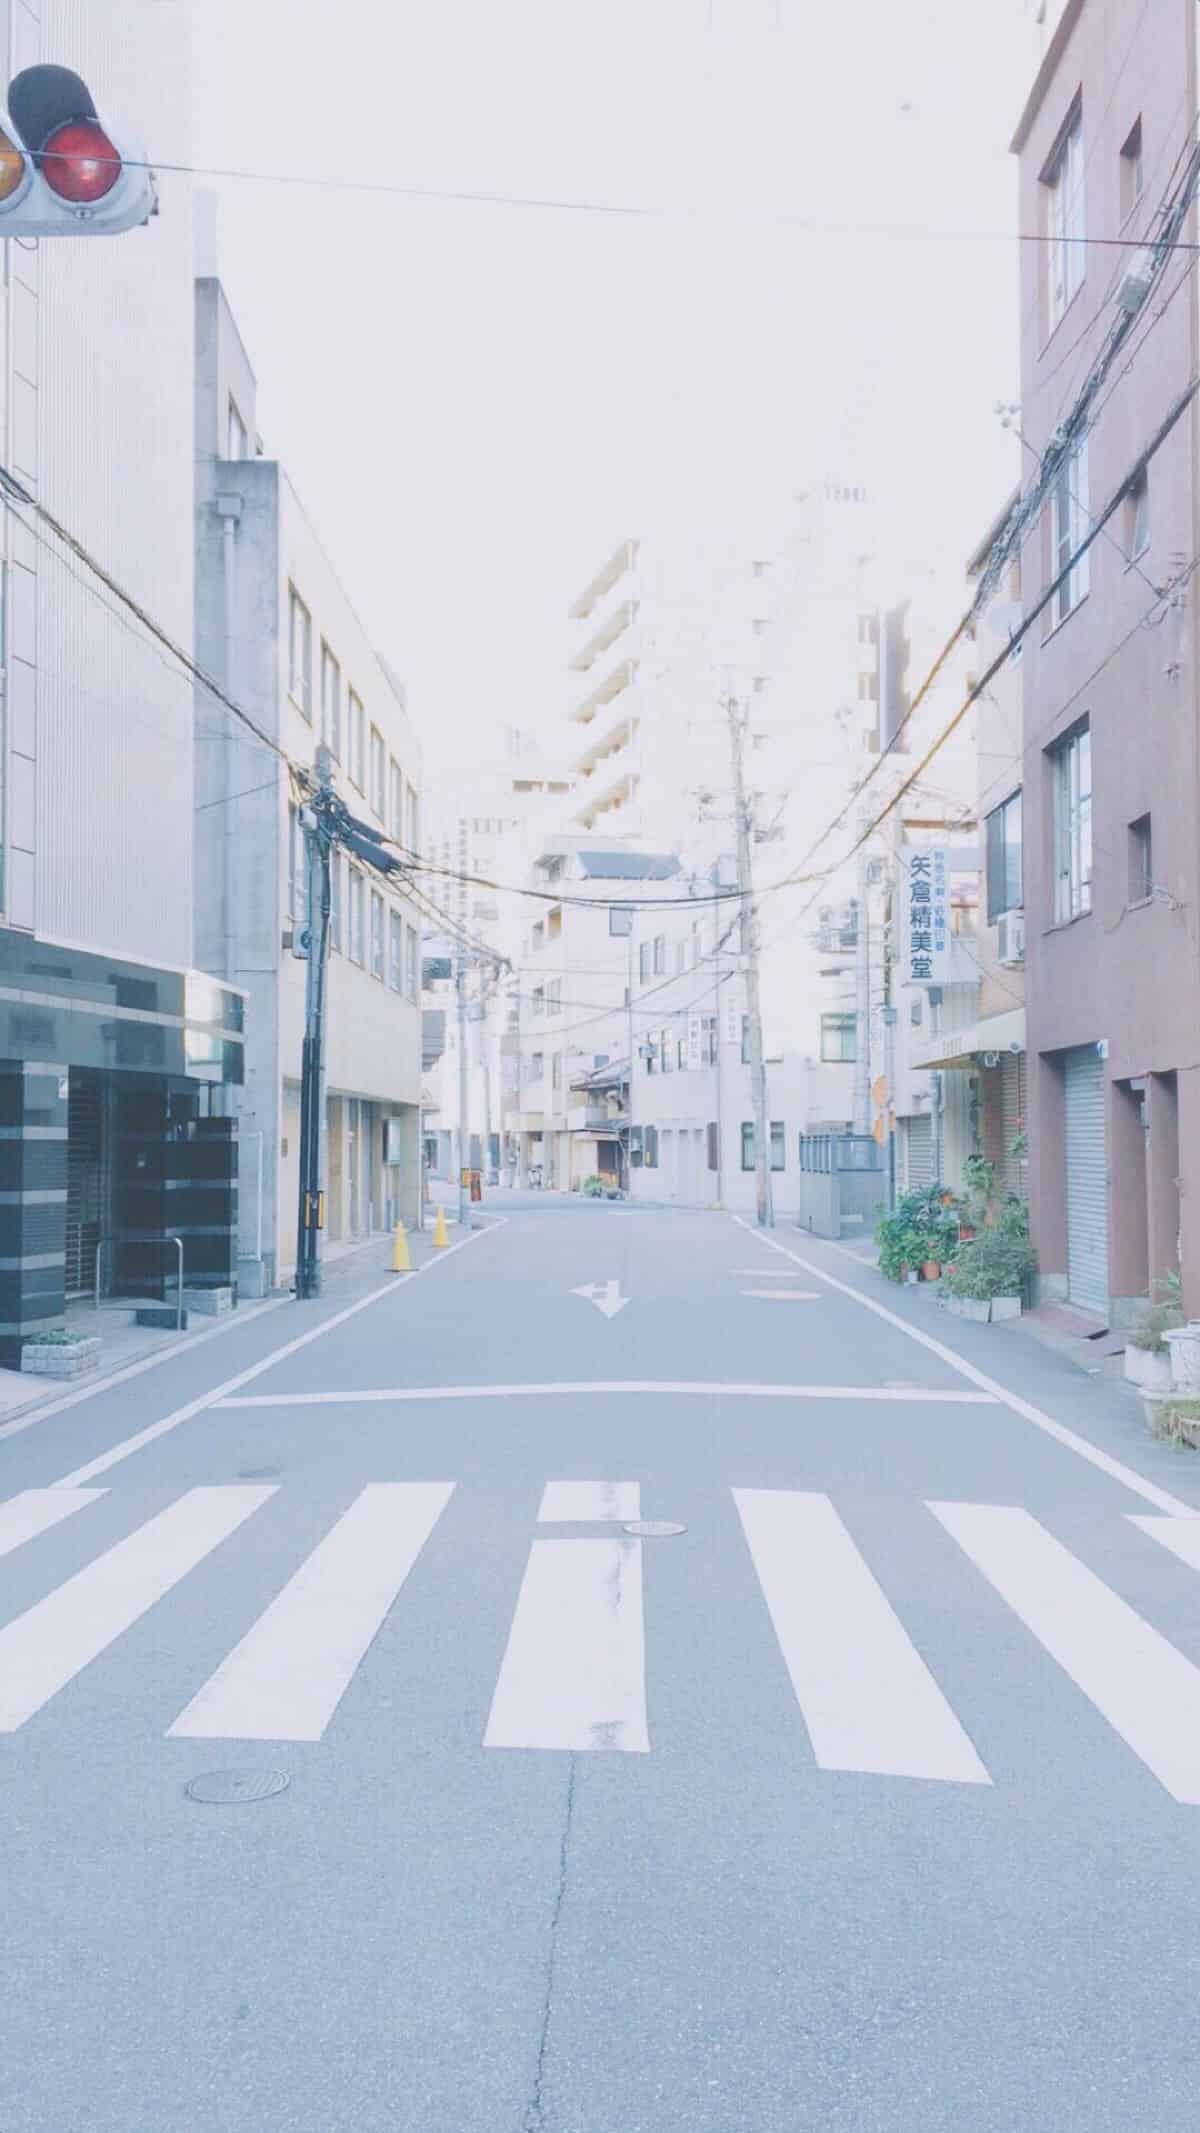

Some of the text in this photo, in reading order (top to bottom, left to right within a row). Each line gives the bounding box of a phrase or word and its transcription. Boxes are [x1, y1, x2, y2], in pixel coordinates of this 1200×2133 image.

[910, 856, 932, 979] 矢倉精美堂
